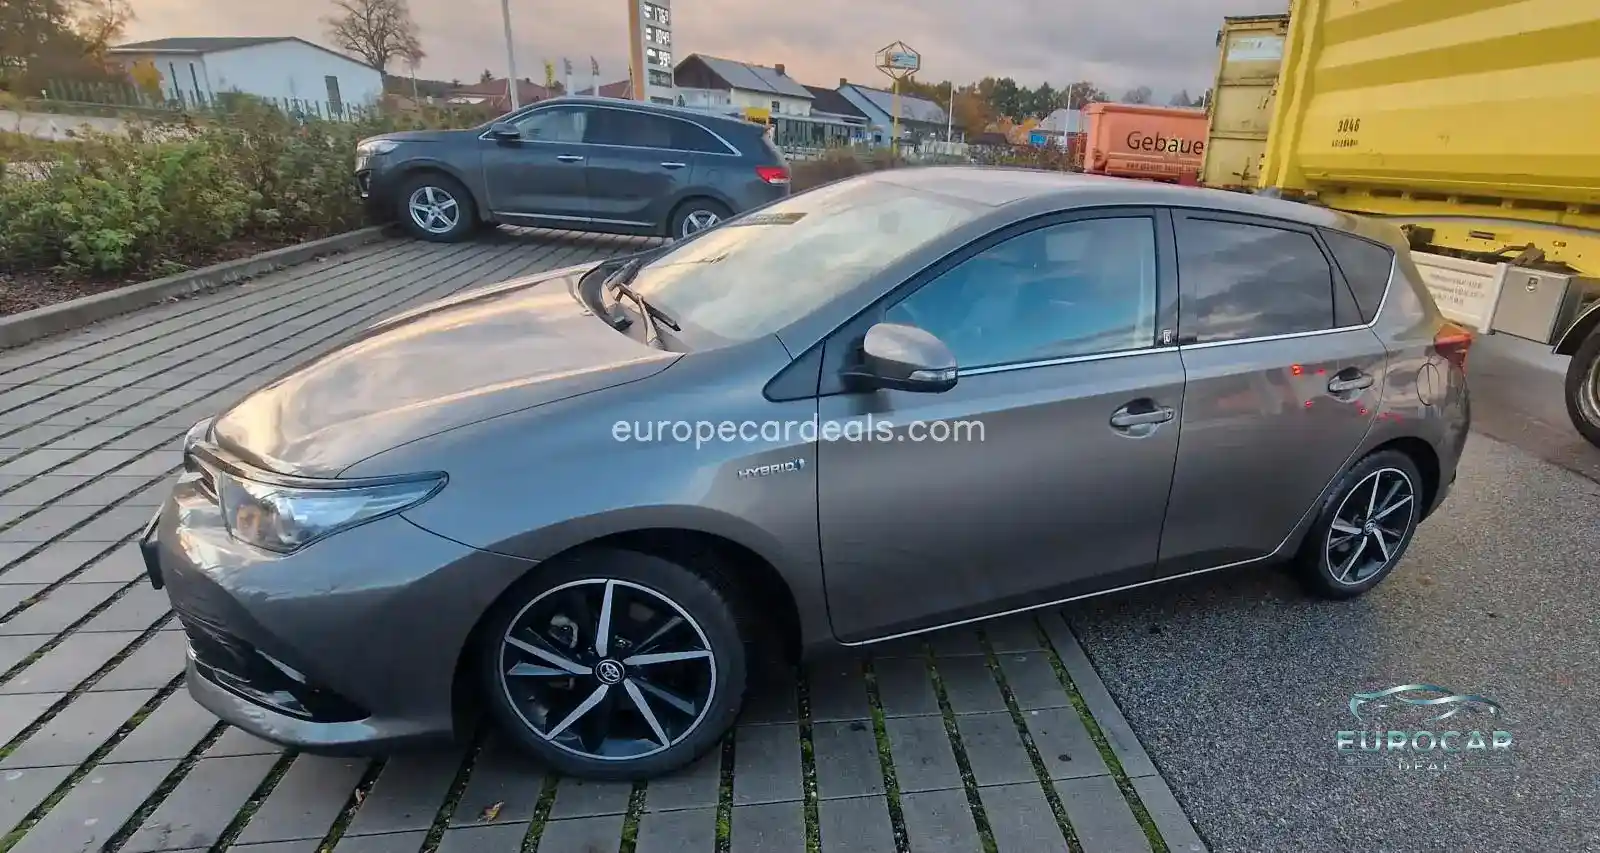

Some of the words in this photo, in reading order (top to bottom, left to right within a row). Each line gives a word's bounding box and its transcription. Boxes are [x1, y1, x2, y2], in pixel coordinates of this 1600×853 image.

[1337, 118, 1361, 132] 3046
[1126, 130, 1204, 155] Gebaue
[737, 462, 795, 479] HYBRID
